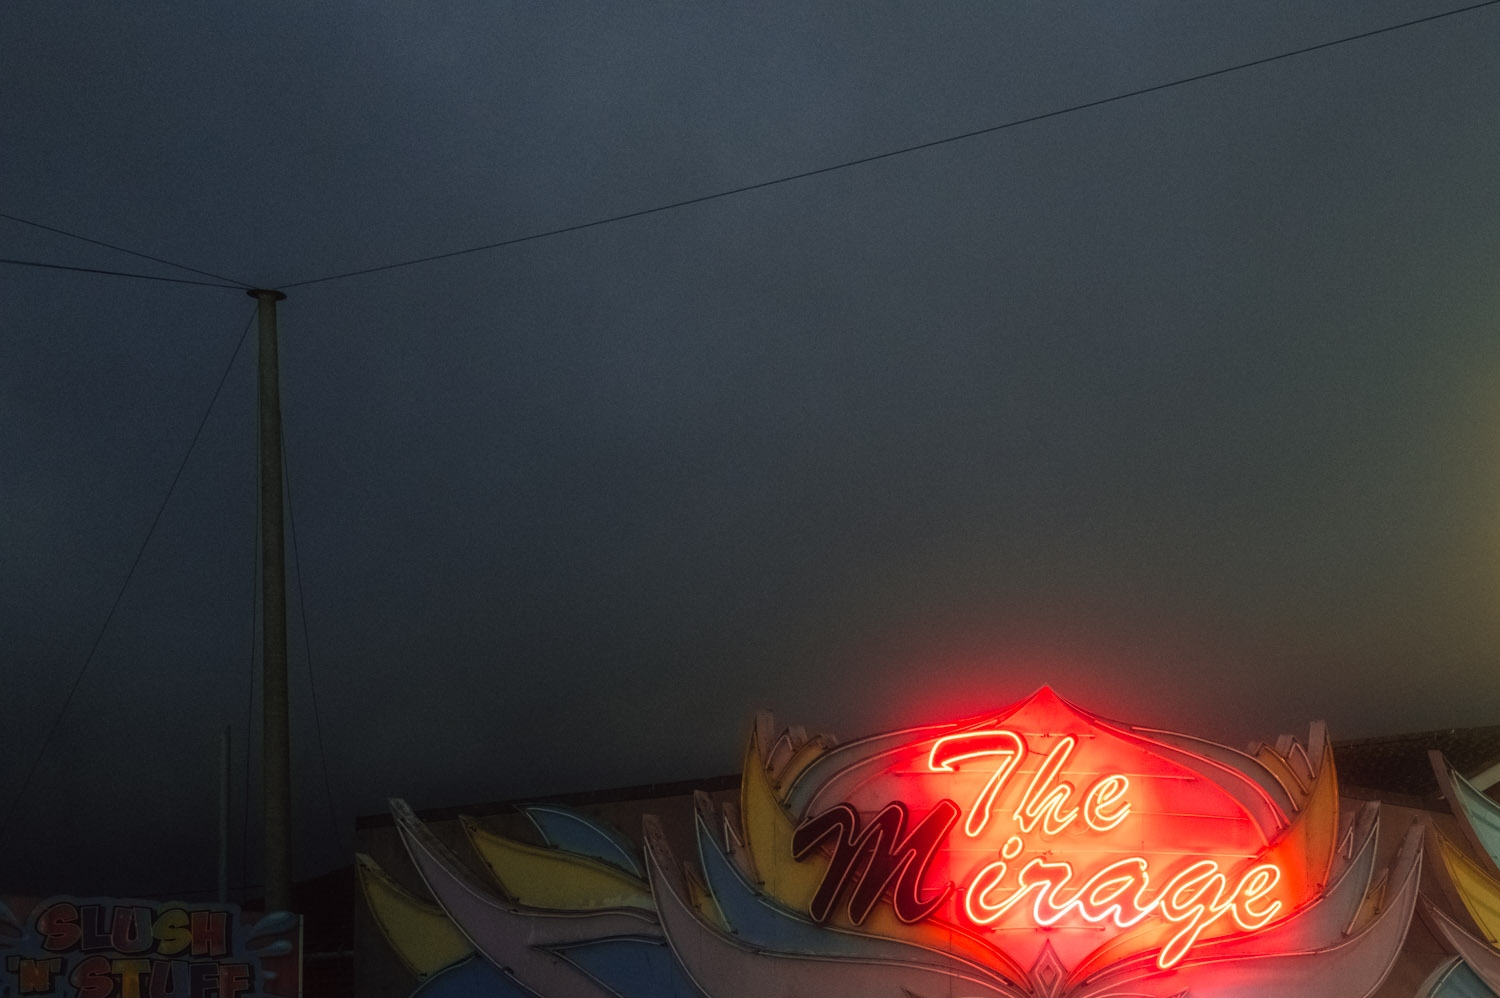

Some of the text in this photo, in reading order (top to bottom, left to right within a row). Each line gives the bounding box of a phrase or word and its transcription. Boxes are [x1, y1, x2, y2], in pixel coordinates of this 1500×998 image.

[927, 729, 1132, 837] The
[791, 798, 1284, 969] Mirage
[37, 902, 233, 957] SLUSH
[7, 954, 65, 994] 'N'
